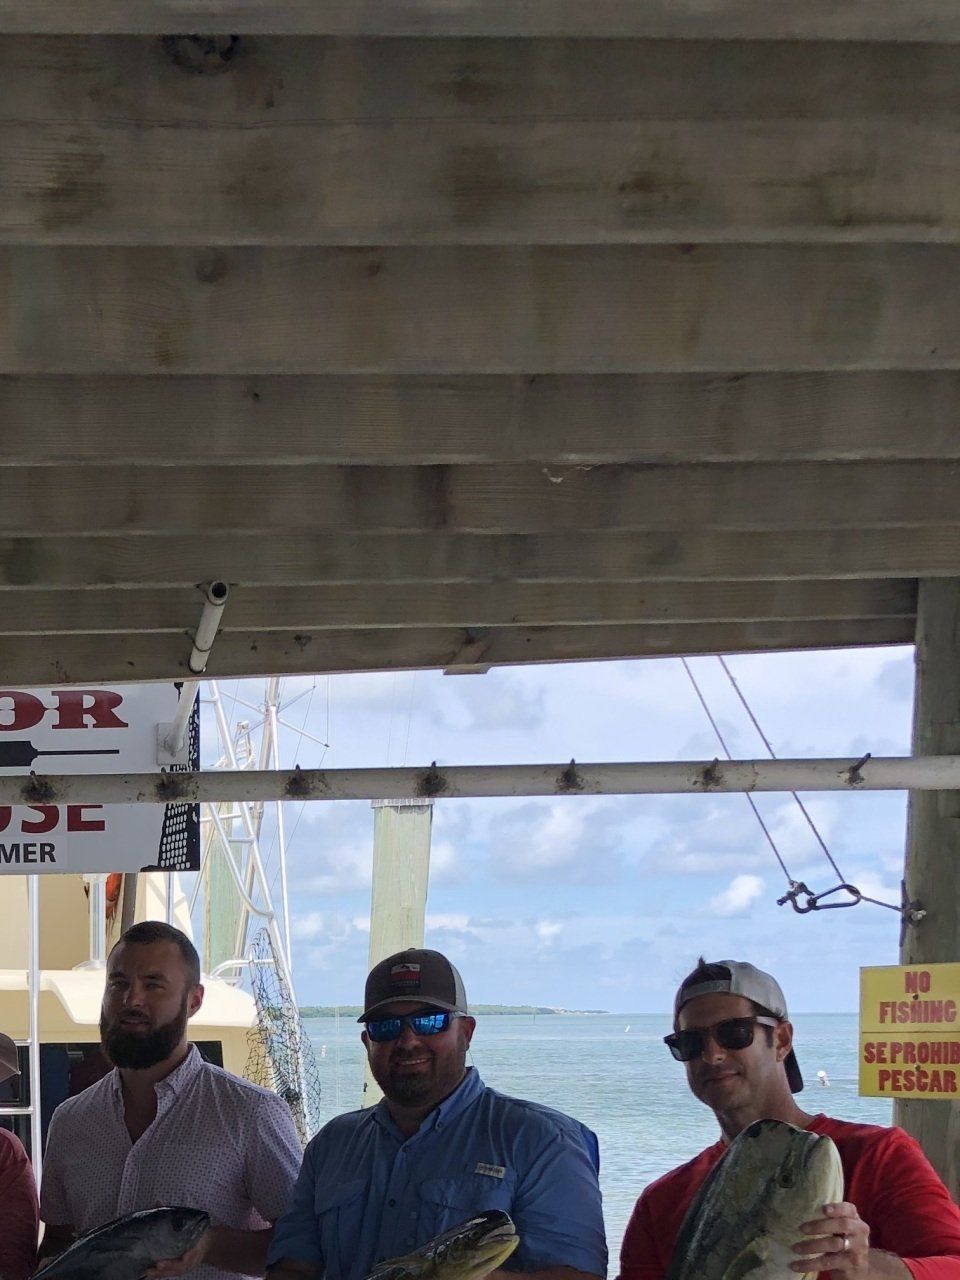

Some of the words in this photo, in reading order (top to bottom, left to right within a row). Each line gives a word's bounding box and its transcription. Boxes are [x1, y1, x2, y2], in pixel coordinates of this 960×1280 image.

[904, 970, 931, 994] NO
[878, 999, 958, 1024] FISHING
[863, 1041, 888, 1064] SE
[878, 1069, 958, 1093] PESCAR
